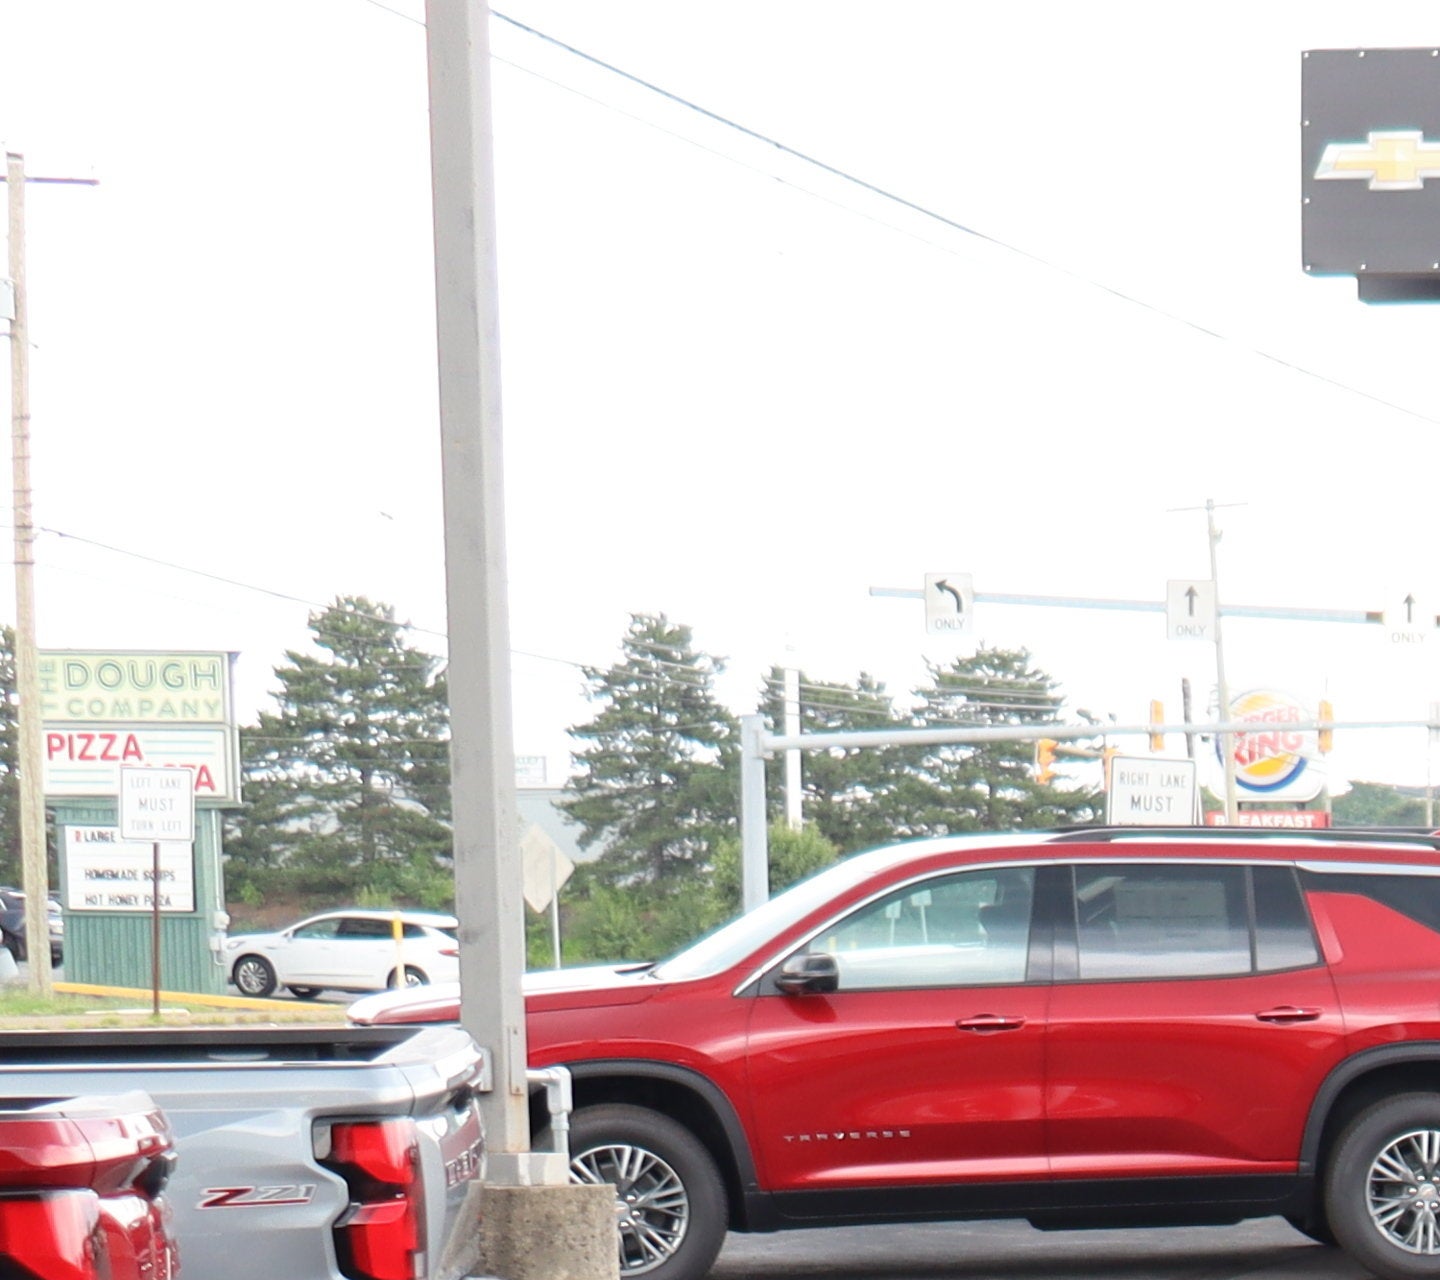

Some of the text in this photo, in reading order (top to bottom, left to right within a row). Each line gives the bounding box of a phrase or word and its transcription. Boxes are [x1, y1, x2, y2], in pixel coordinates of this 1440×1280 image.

[935, 618, 965, 631] ONLY
[1175, 625, 1206, 637] ONLY
[1391, 631, 1426, 645] ONLY
[63, 659, 221, 691] DOUGH
[66, 698, 220, 718] COMPANY
[46, 733, 143, 761] PIZZA
[131, 777, 151, 790] LEFT
[160, 777, 182, 790] LANE
[1119, 770, 1187, 788] RIGHT LANE
[138, 798, 175, 812] MUST
[1130, 795, 1175, 812] MUST
[131, 820, 182, 832] TURN LEFT
[1214, 814, 1315, 828] BEAKFAST
[85, 893, 104, 906] HOT
[197, 1184, 318, 1210] Z71
